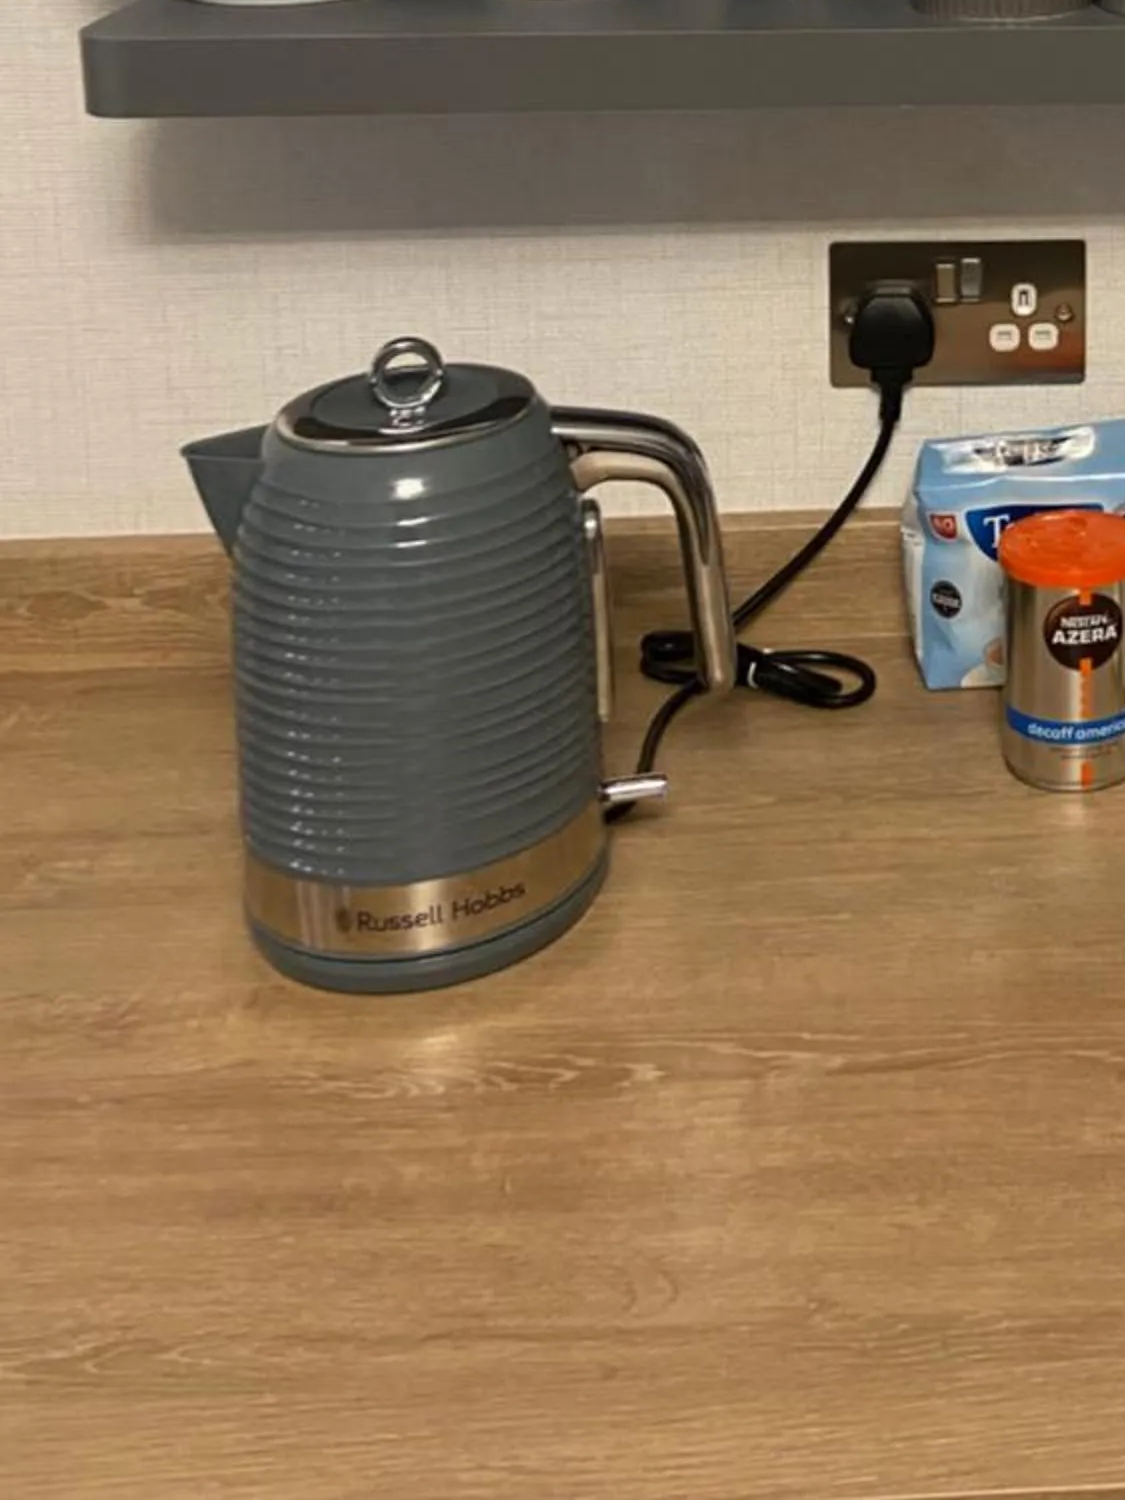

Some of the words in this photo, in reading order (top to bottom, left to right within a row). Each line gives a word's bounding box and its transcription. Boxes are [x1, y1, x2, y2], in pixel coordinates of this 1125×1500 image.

[1051, 624, 1118, 645] AZERA
[1027, 721, 1074, 741] decaff
[356, 904, 444, 933] Russell
[451, 883, 527, 921] Hobbs
